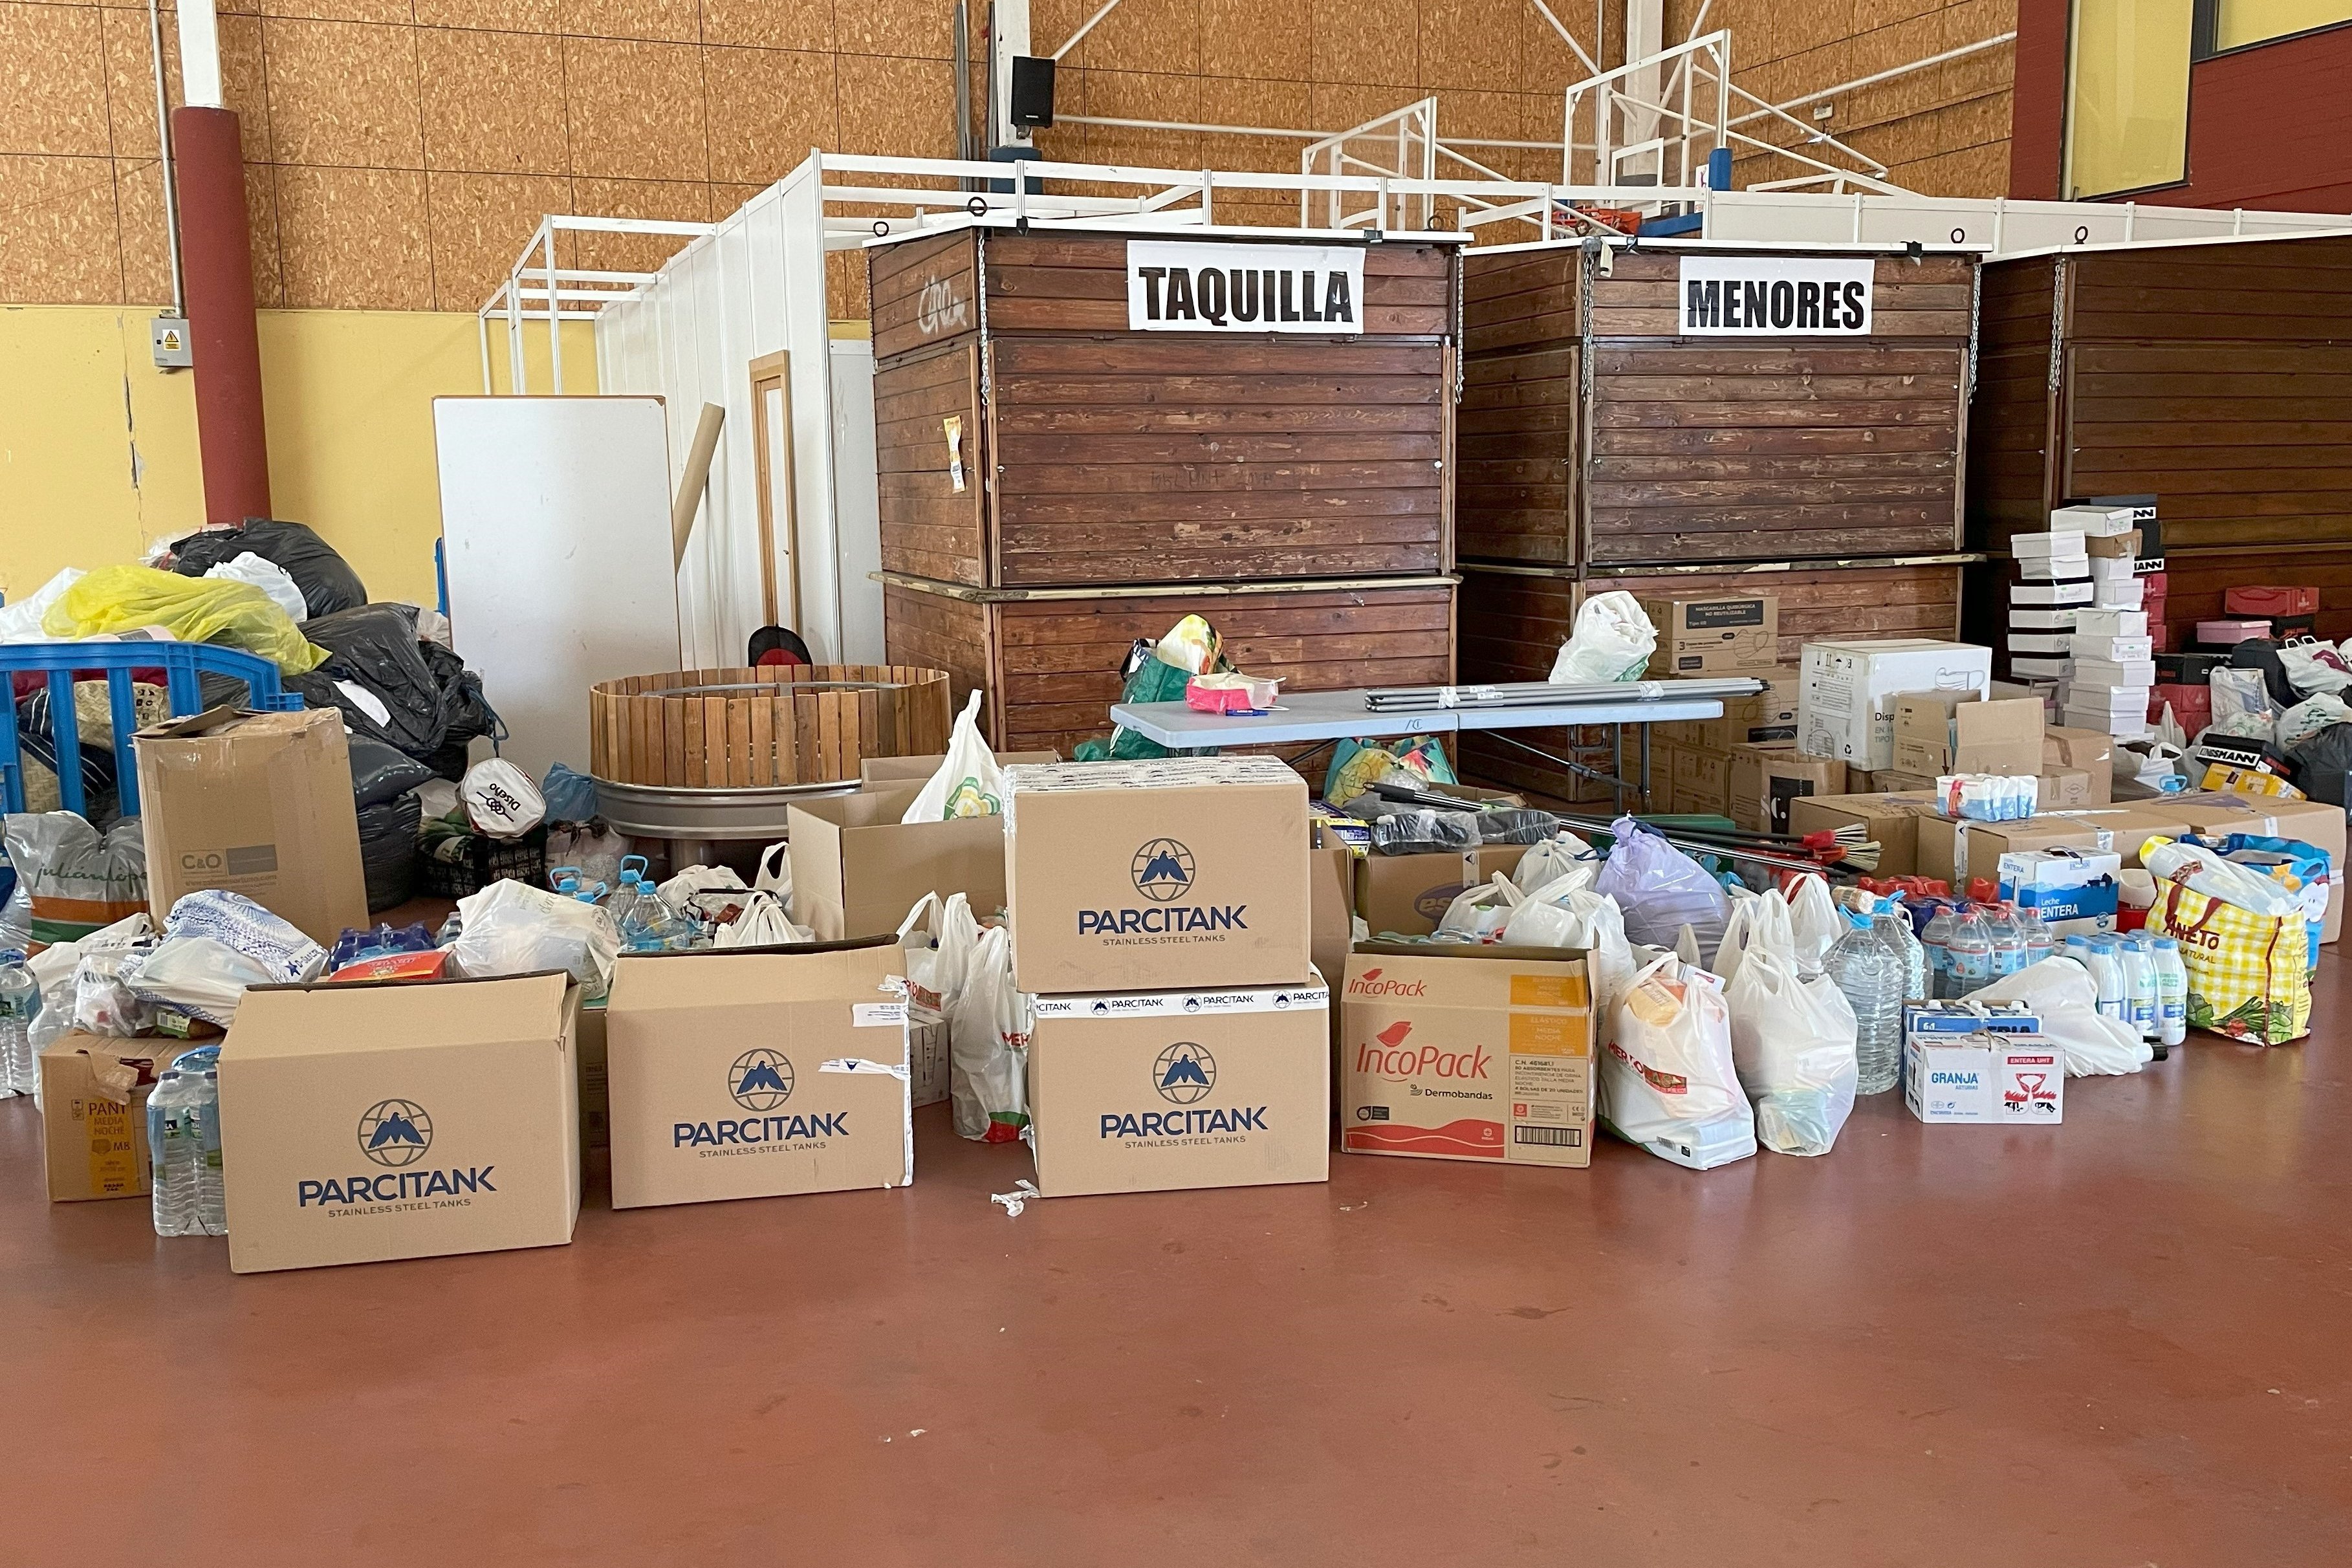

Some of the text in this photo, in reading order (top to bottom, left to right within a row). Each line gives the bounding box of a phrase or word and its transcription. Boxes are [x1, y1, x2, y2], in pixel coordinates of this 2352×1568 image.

[1138, 267, 1354, 326] TAQUILLA
[1688, 280, 1864, 329] MENORES
[182, 854, 222, 869] C&O
[2004, 862, 2024, 873] ENTERA
[2042, 897, 2060, 906] Leche
[2041, 904, 2079, 919] ENTERA
[1079, 905, 1248, 935] PARCITANK
[1103, 937, 1157, 946] STAINLESS
[1349, 979, 1427, 996] IncoPack
[1112, 999, 1164, 1008] PARCITANK
[1203, 995, 1254, 1004] PARCITANK
[1356, 1043, 1492, 1079] IncoPack
[1932, 1073, 1978, 1083] GRANJA
[1425, 1089, 1493, 1100] Dermobandas
[93, 1116, 124, 1126] MEDIA
[1101, 1106, 1269, 1138] PARCITANK
[674, 1112, 849, 1148] PARCITANK
[699, 1142, 826, 1157] STAINLESS STEEL TANKS
[1125, 1135, 1246, 1149] STAINLESS STEEL TANKS
[299, 1166, 497, 1207] PARCITANK
[329, 1199, 471, 1217] STAINLESS STEEL TANKS
